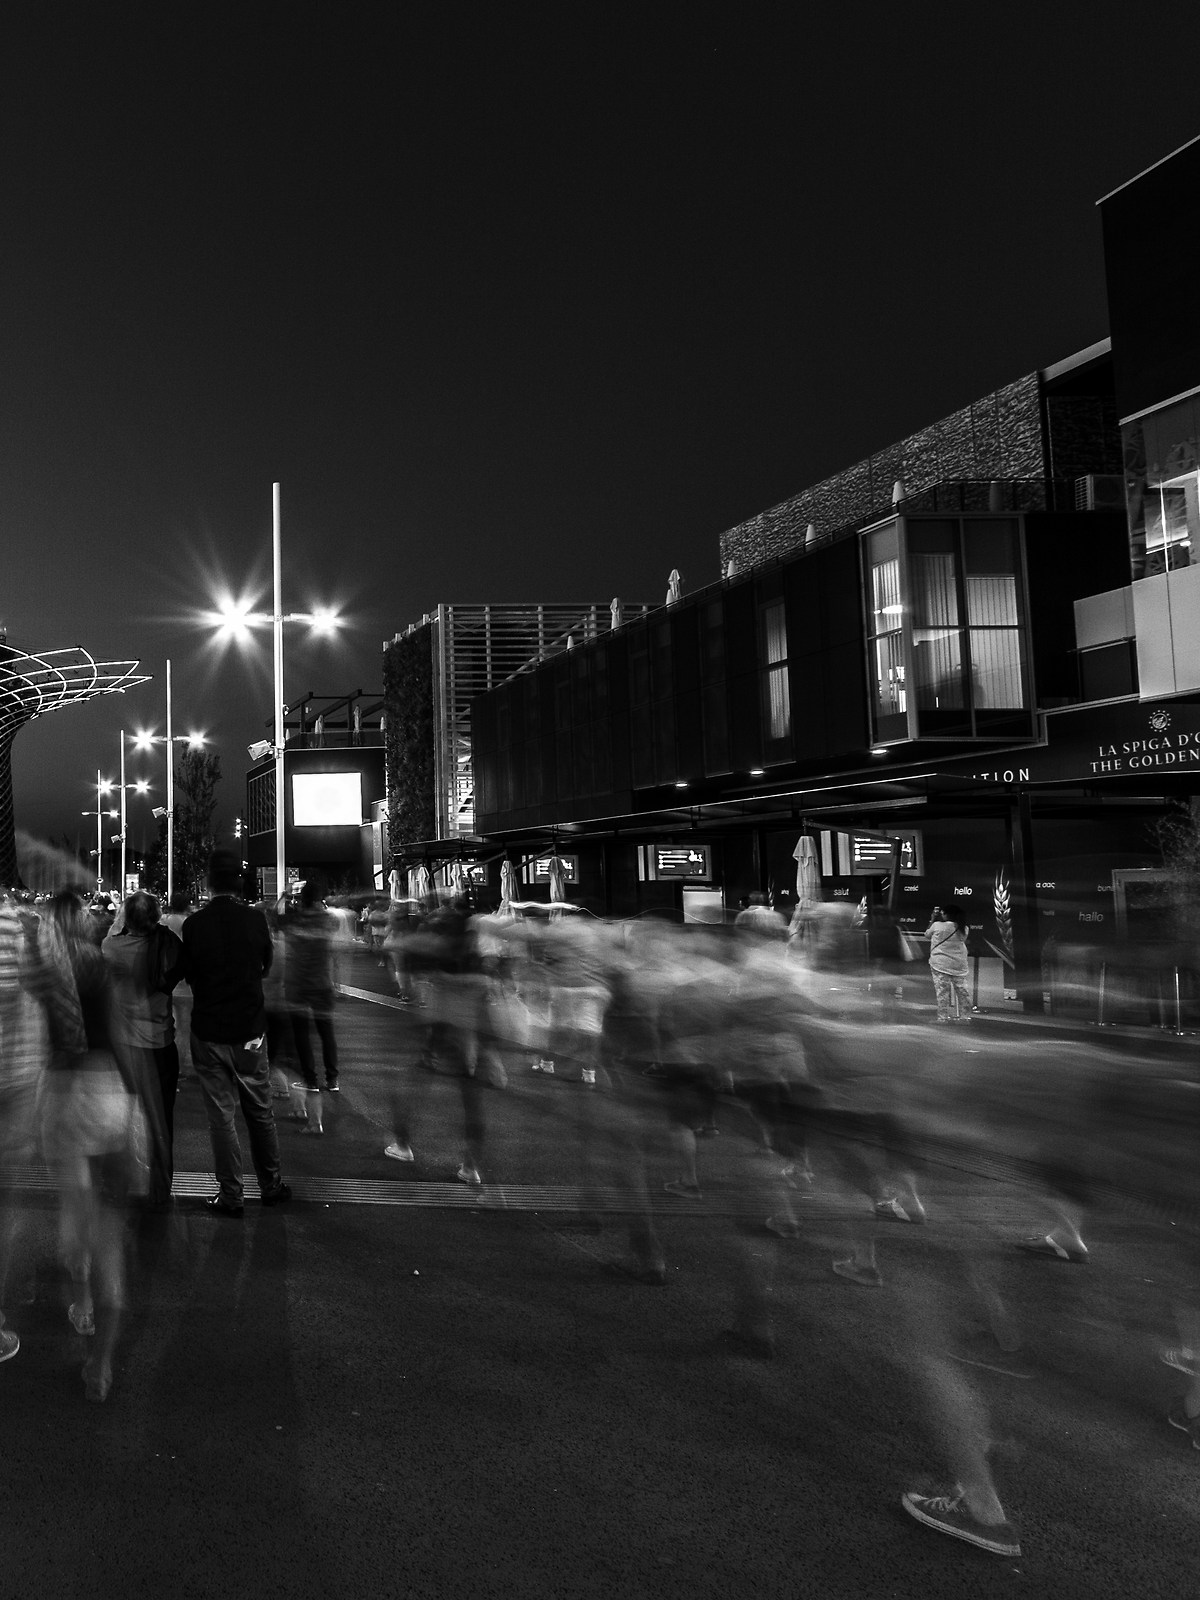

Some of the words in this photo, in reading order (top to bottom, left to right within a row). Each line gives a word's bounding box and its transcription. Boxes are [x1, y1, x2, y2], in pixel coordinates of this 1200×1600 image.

[1098, 744, 1117, 758] LA
[1122, 736, 1172, 755] SPIGA
[1090, 758, 1122, 773] THE
[1128, 748, 1200, 770] GOLDEN
[953, 886, 974, 896] hello
[1078, 911, 1104, 923] hallo
